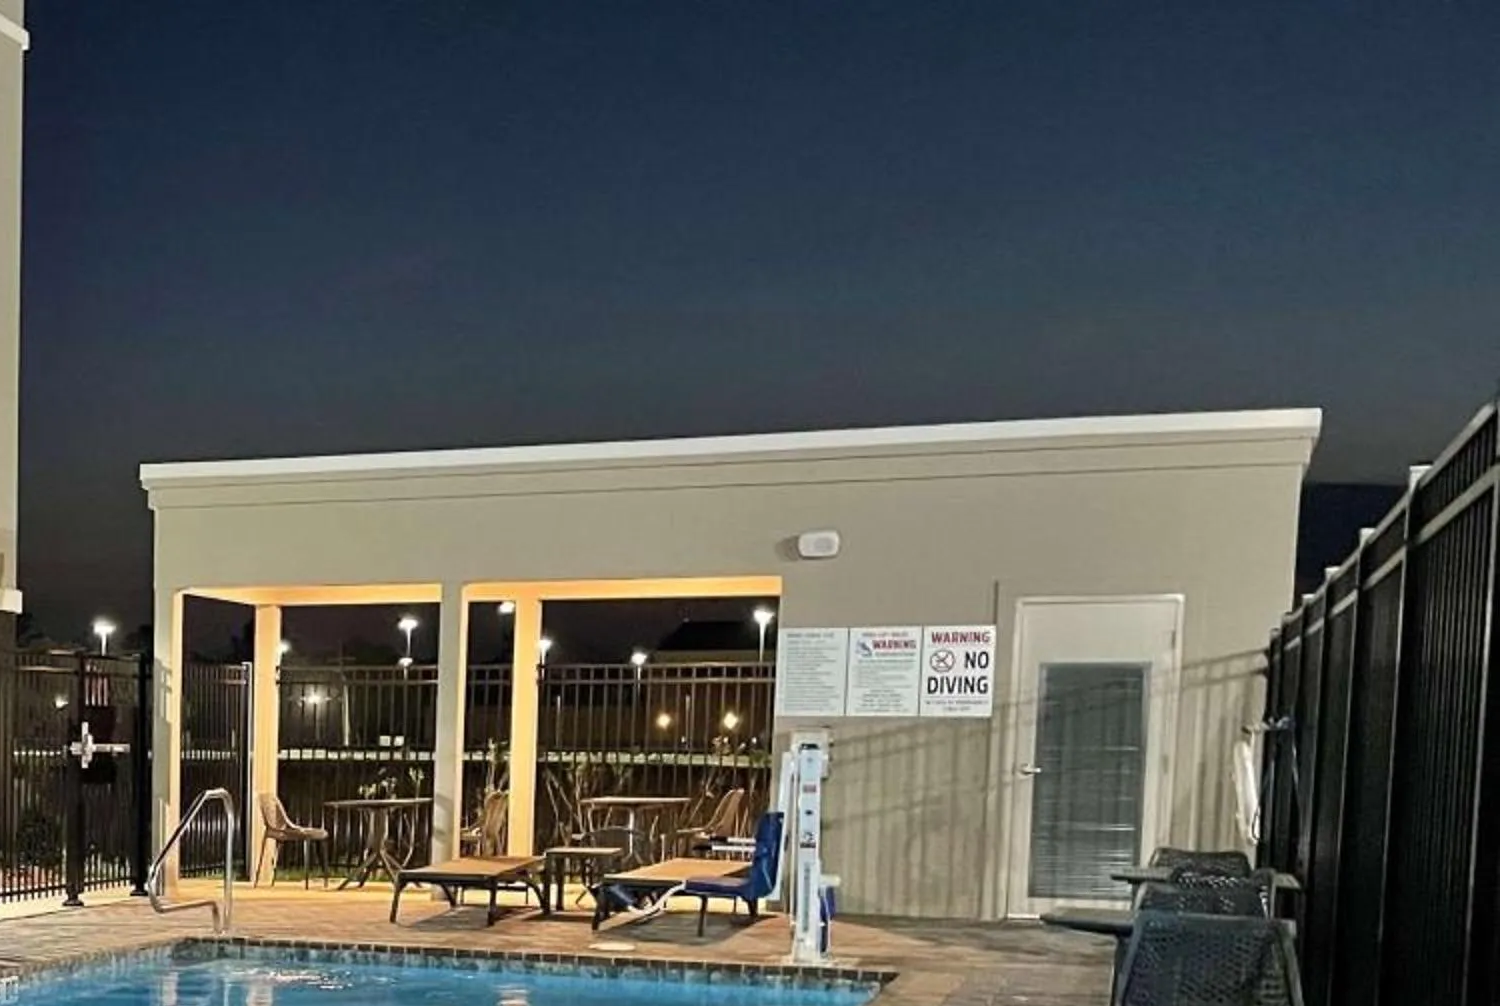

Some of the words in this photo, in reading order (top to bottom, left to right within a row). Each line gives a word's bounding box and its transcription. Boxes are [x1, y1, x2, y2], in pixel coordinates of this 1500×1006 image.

[872, 639, 917, 649] WARNING
[931, 631, 990, 644] WARNING
[964, 650, 990, 669] NO
[927, 675, 989, 695] DIVING
